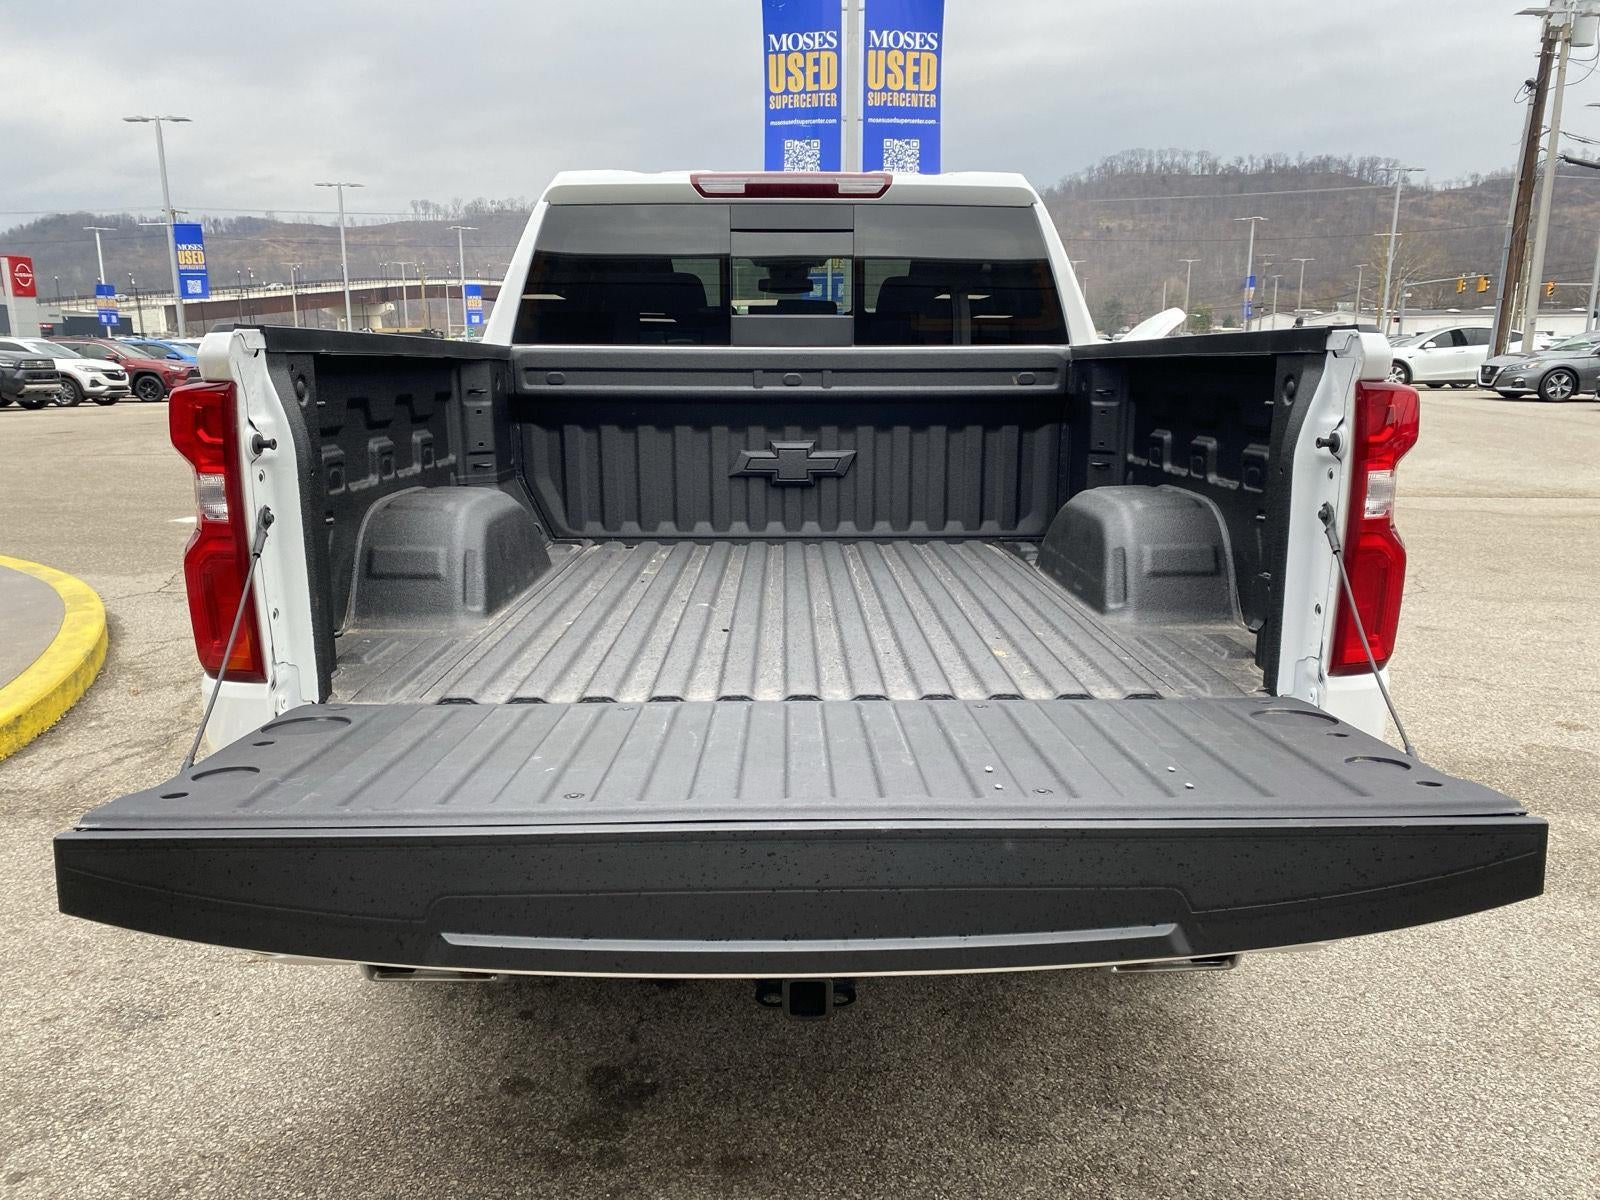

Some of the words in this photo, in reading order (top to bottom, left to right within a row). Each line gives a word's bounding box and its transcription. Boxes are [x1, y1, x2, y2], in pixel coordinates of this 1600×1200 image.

[768, 31, 838, 52] MOSES
[868, 30, 938, 50] MOSES
[768, 51, 838, 93] USED
[867, 50, 938, 91] USED
[769, 93, 837, 110] SUPERCENTER
[867, 92, 937, 108] SUPERCENTER
[769, 118, 837, 127] mosesusedsupercenter.com
[868, 117, 937, 125] mosesusedsupercenter.com
[177, 243, 203, 251] MOSES
[177, 250, 205, 265] USED
